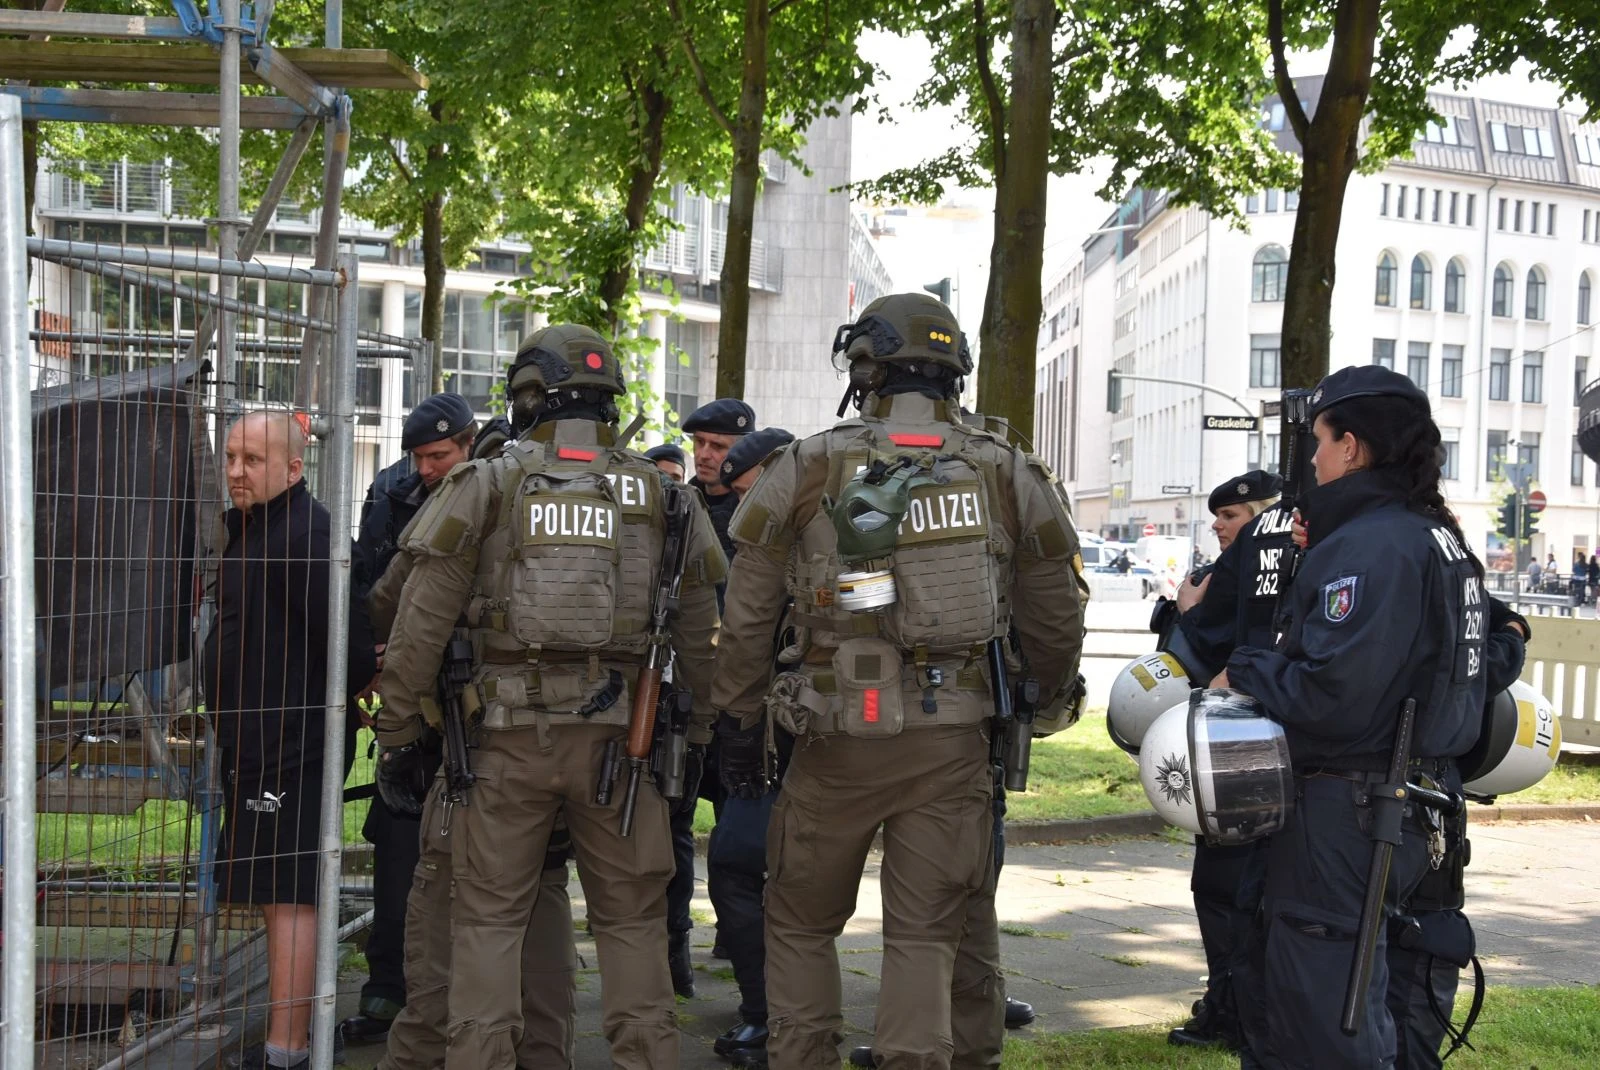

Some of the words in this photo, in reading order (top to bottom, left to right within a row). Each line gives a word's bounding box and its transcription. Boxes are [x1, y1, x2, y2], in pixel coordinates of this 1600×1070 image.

[1207, 416, 1255, 429] Graskeller
[530, 503, 613, 539] POLIZEI
[1260, 549, 1283, 570] NR
